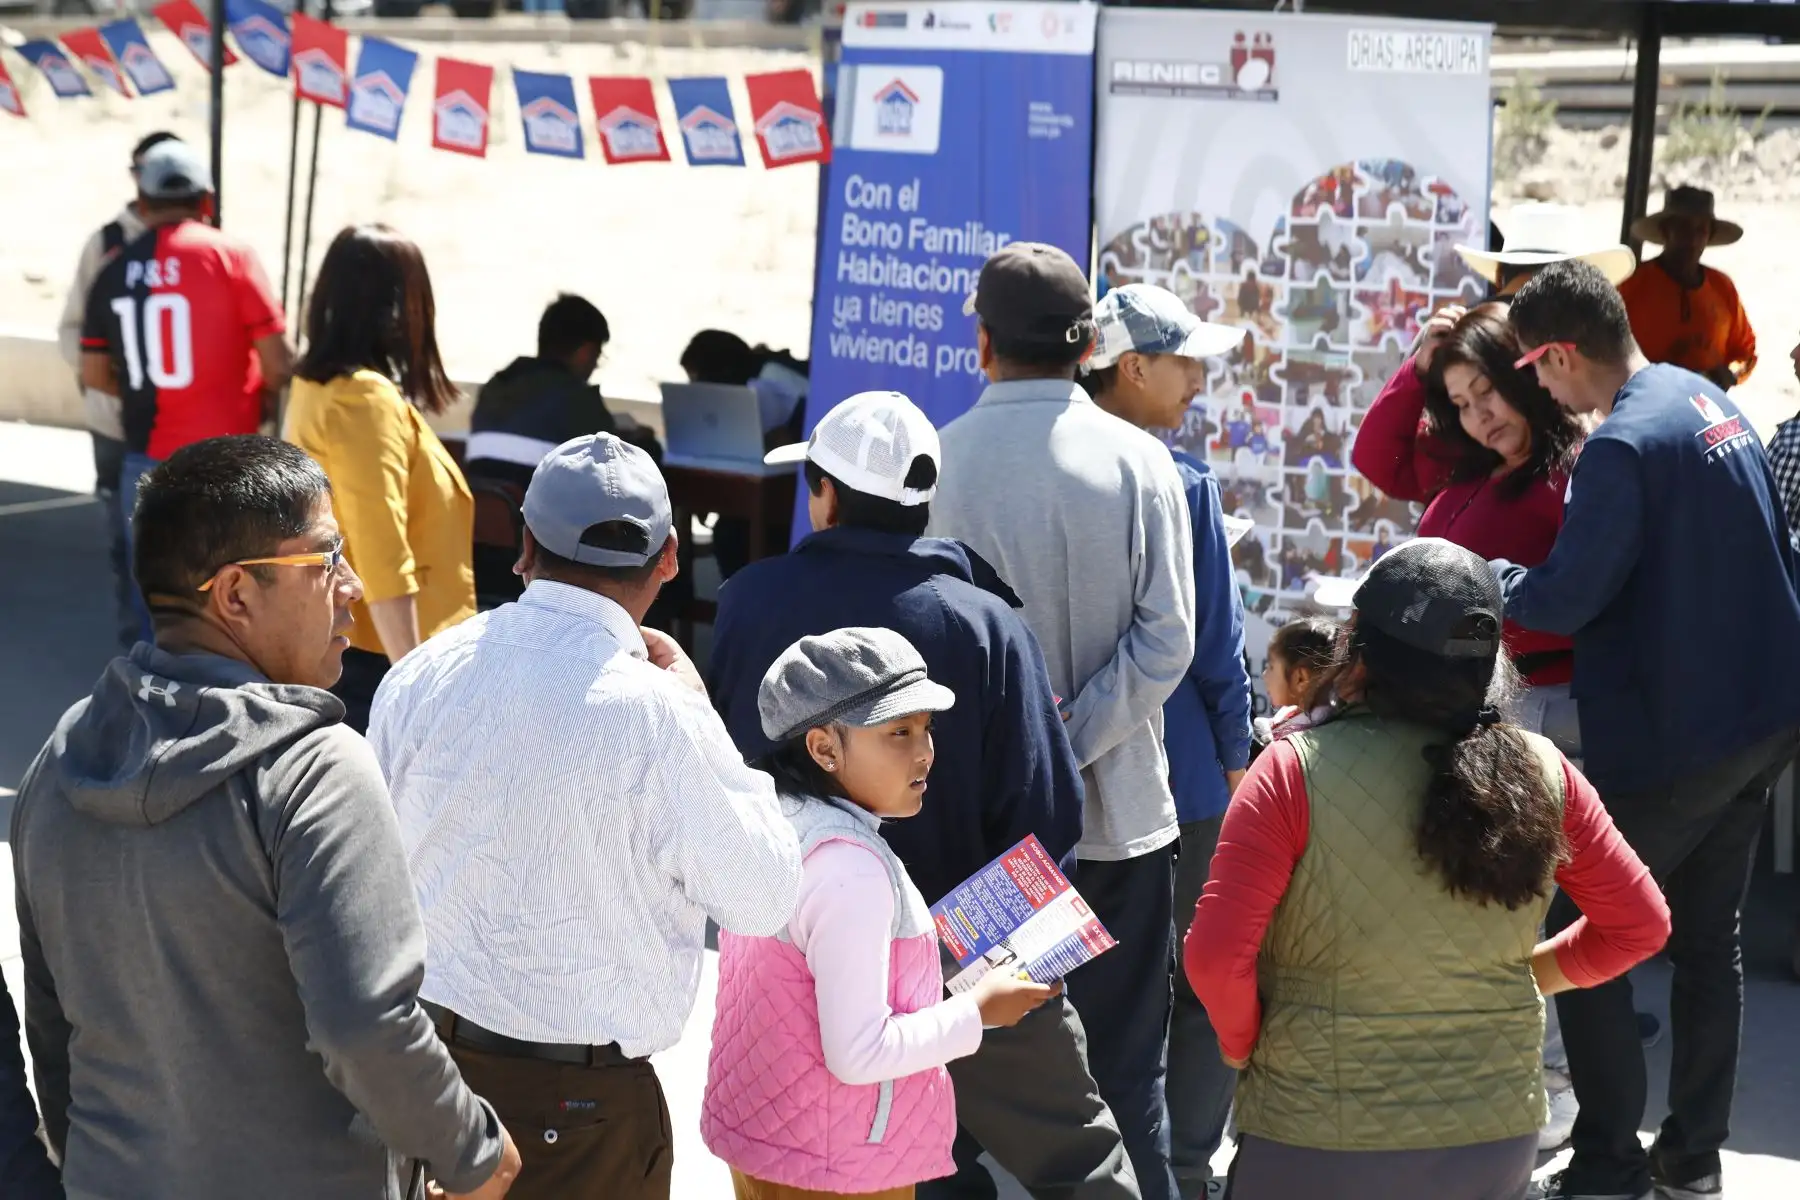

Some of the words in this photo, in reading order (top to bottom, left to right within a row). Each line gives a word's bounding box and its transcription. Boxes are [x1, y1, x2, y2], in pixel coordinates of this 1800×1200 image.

[1113, 61, 1220, 85] RENIEC
[1351, 34, 1393, 68] DRIAS
[1404, 36, 1478, 71] AREQUIPA
[845, 174, 892, 210] Con
[898, 177, 920, 212] el
[841, 212, 903, 250] Bono
[908, 217, 1010, 258] Familiar
[837, 250, 982, 295] Habitaciona
[832, 294, 861, 329] ya
[869, 292, 944, 332] tienes
[110, 293, 194, 390] 10
[829, 326, 928, 368] vivienda
[935, 345, 989, 384] pro
[1029, 842, 1043, 859] ROBO
[1041, 857, 1064, 886] AGRAVADO
